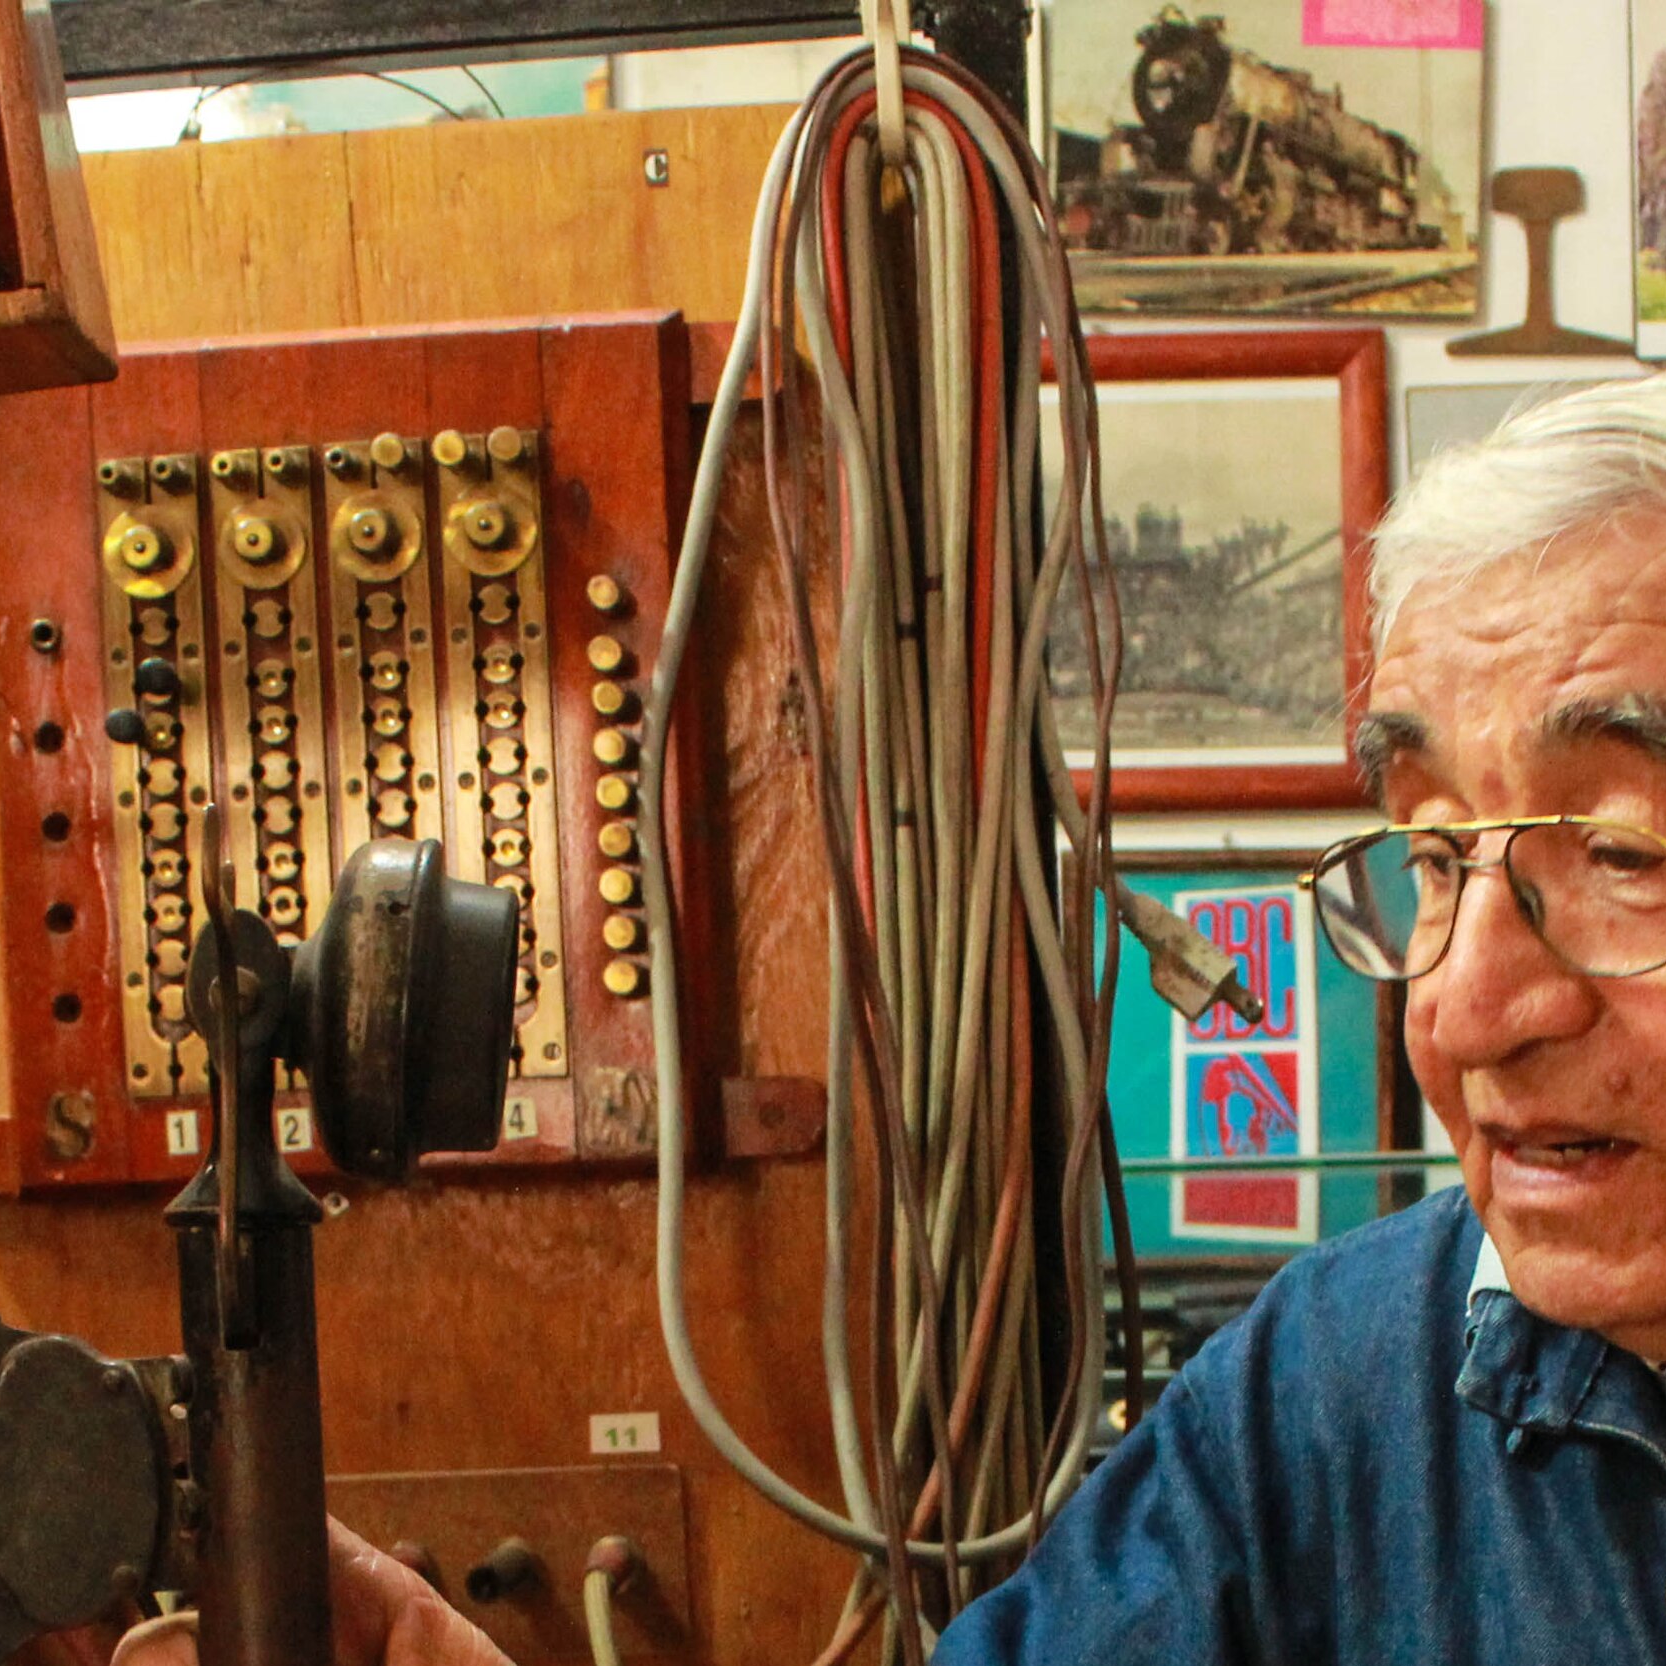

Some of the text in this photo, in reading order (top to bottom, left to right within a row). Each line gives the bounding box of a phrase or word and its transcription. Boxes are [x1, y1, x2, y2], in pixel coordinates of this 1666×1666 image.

[644, 153, 667, 183] C
[173, 1117, 185, 1149] 1
[284, 1115, 300, 1146] 2
[507, 1102, 525, 1134] 4
[604, 1426, 637, 1448] 11
